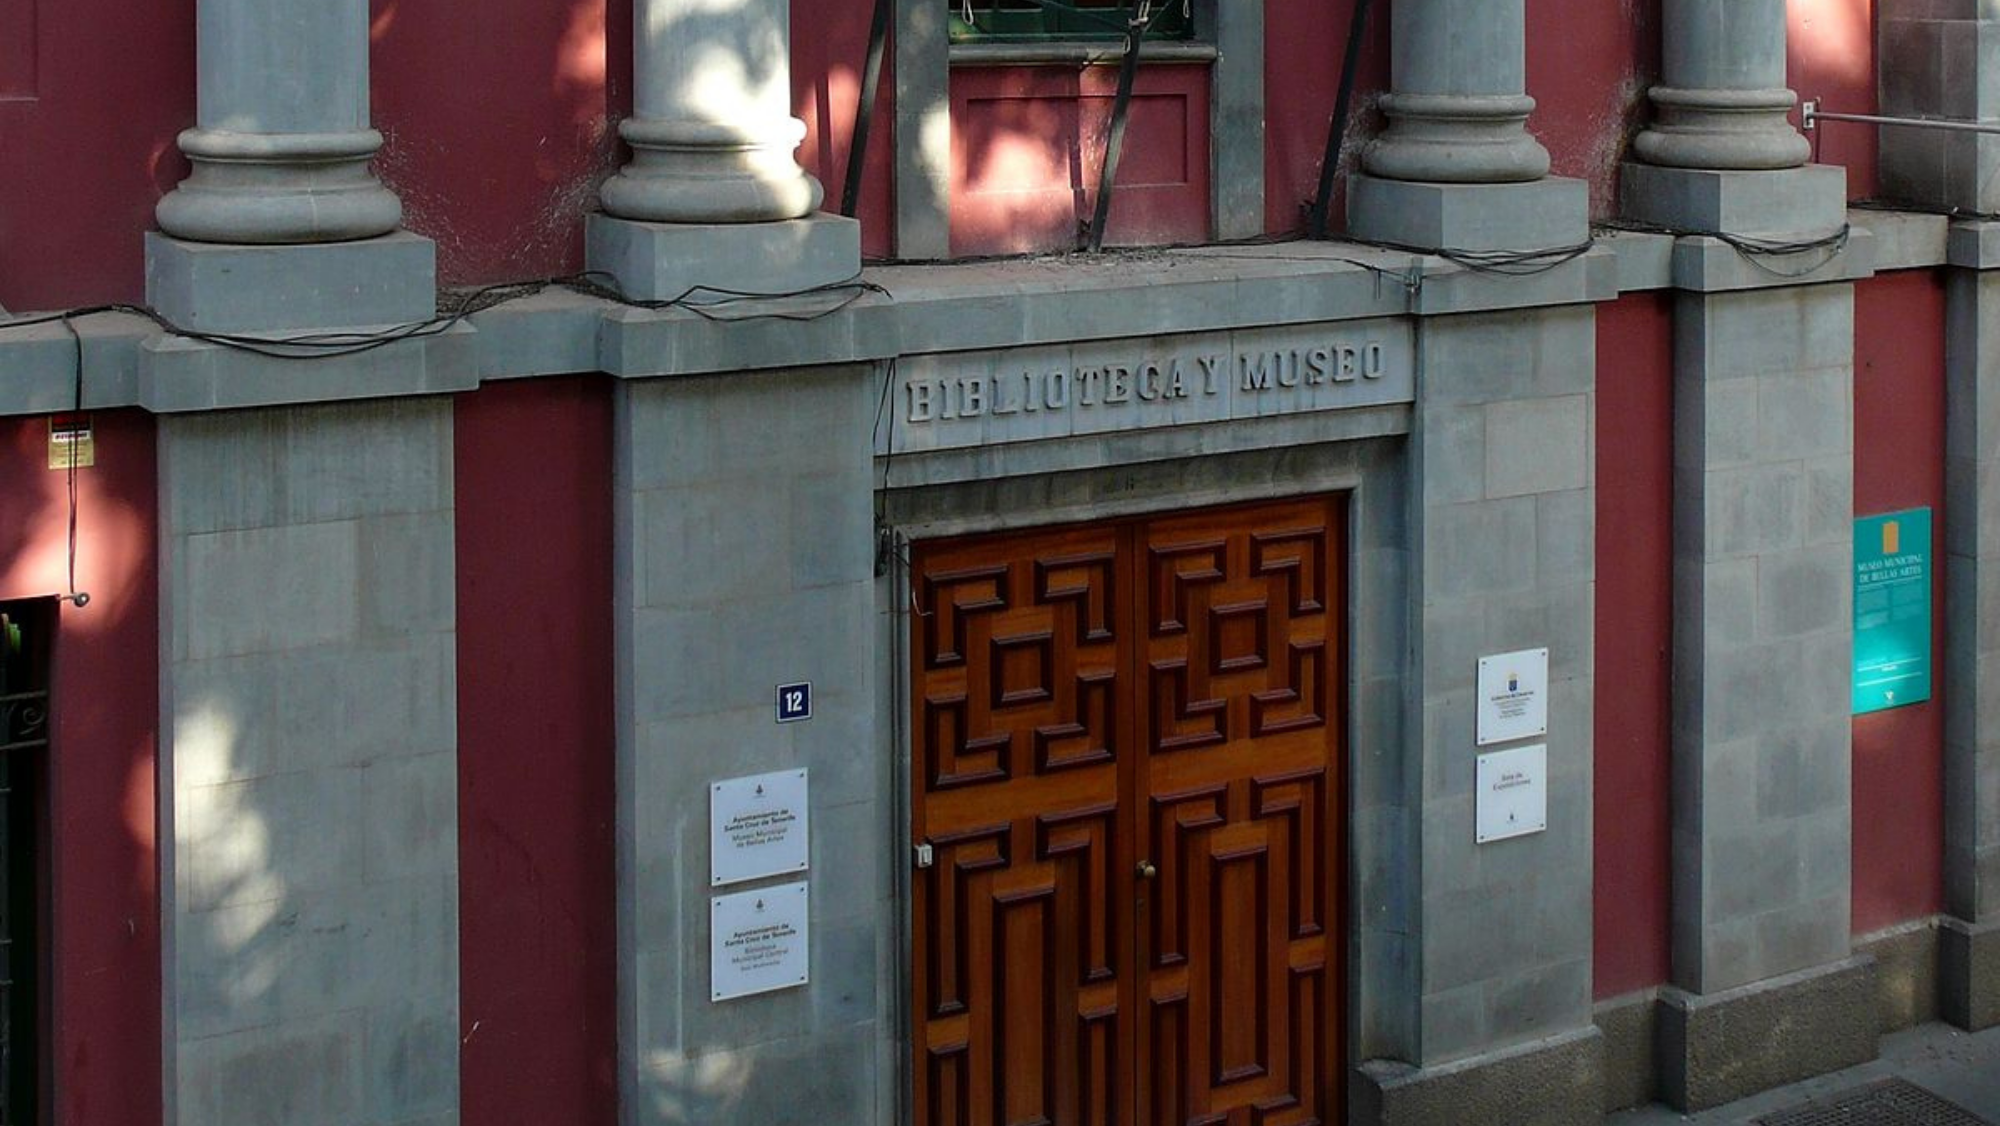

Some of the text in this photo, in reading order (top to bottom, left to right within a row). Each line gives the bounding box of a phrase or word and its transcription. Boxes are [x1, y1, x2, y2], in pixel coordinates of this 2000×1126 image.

[906, 342, 1387, 423] BIBLIOTECA Y MUSEO
[1858, 554, 1922, 571] MUSEO MUNICIPAL
[1860, 565, 1922, 583] DE BELLAS ARTES
[785, 691, 802, 713] 12
[725, 823, 744, 832] Santa
[745, 820, 759, 828] Cruz
[771, 814, 795, 824] Tenerife
[733, 810, 779, 823] Ayuntamiento
[725, 938, 744, 947] Santa
[745, 935, 760, 944] Cruz
[771, 928, 796, 938] Tenerife
[733, 925, 779, 939] Ayuntamiento
